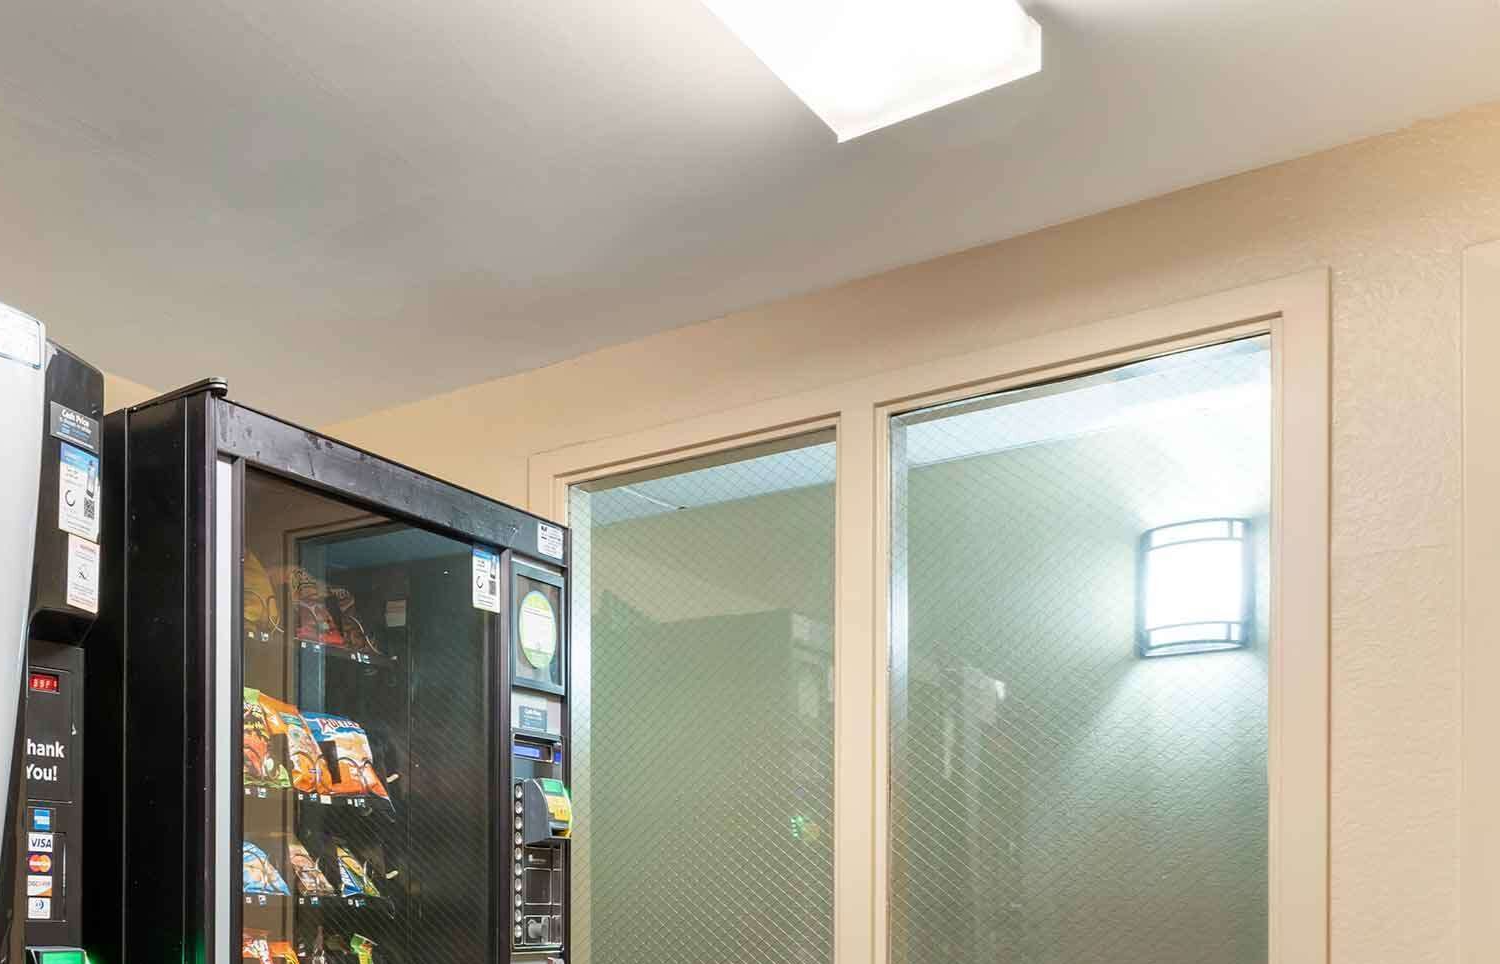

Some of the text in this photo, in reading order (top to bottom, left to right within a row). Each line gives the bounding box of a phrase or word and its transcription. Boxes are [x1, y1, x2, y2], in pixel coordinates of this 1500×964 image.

[26, 738, 65, 759] hank
[26, 763, 58, 781] You!
[31, 838, 52, 848] VISA
